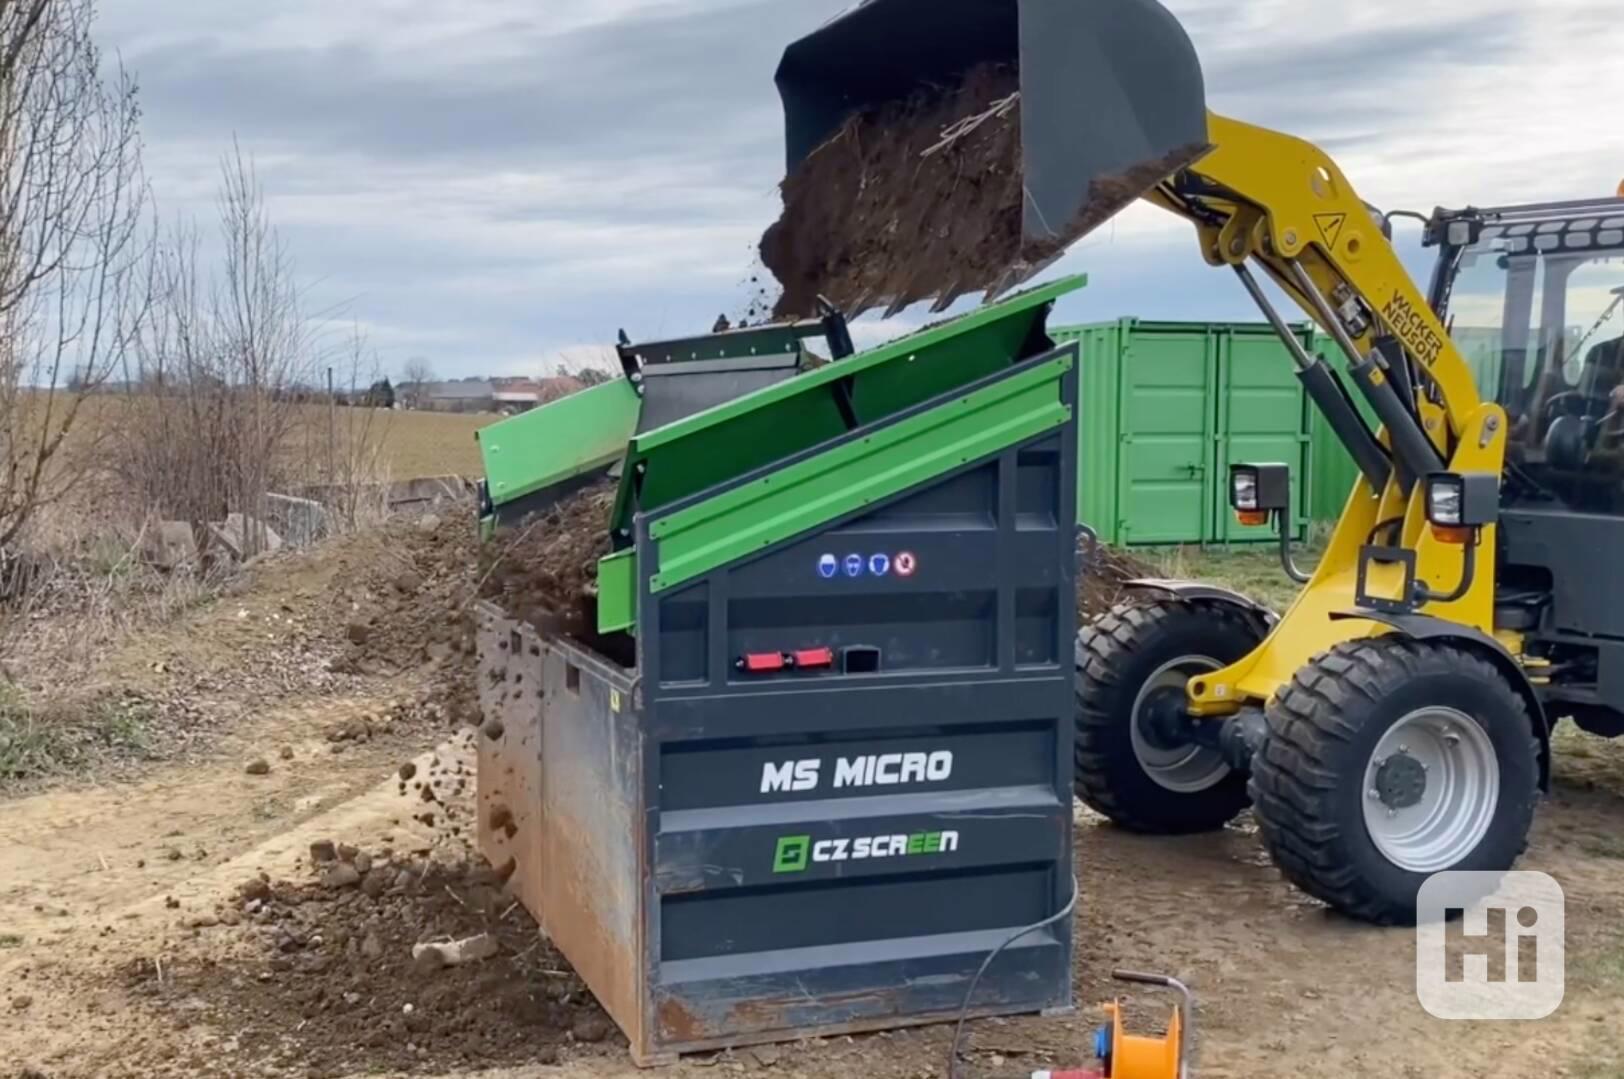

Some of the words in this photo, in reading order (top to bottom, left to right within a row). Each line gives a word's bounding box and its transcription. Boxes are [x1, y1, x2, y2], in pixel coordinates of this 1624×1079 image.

[1382, 302, 1437, 367] NEUSON
[1392, 289, 1443, 355] WACKER
[760, 759, 821, 793] MS
[833, 750, 953, 787] MICRO
